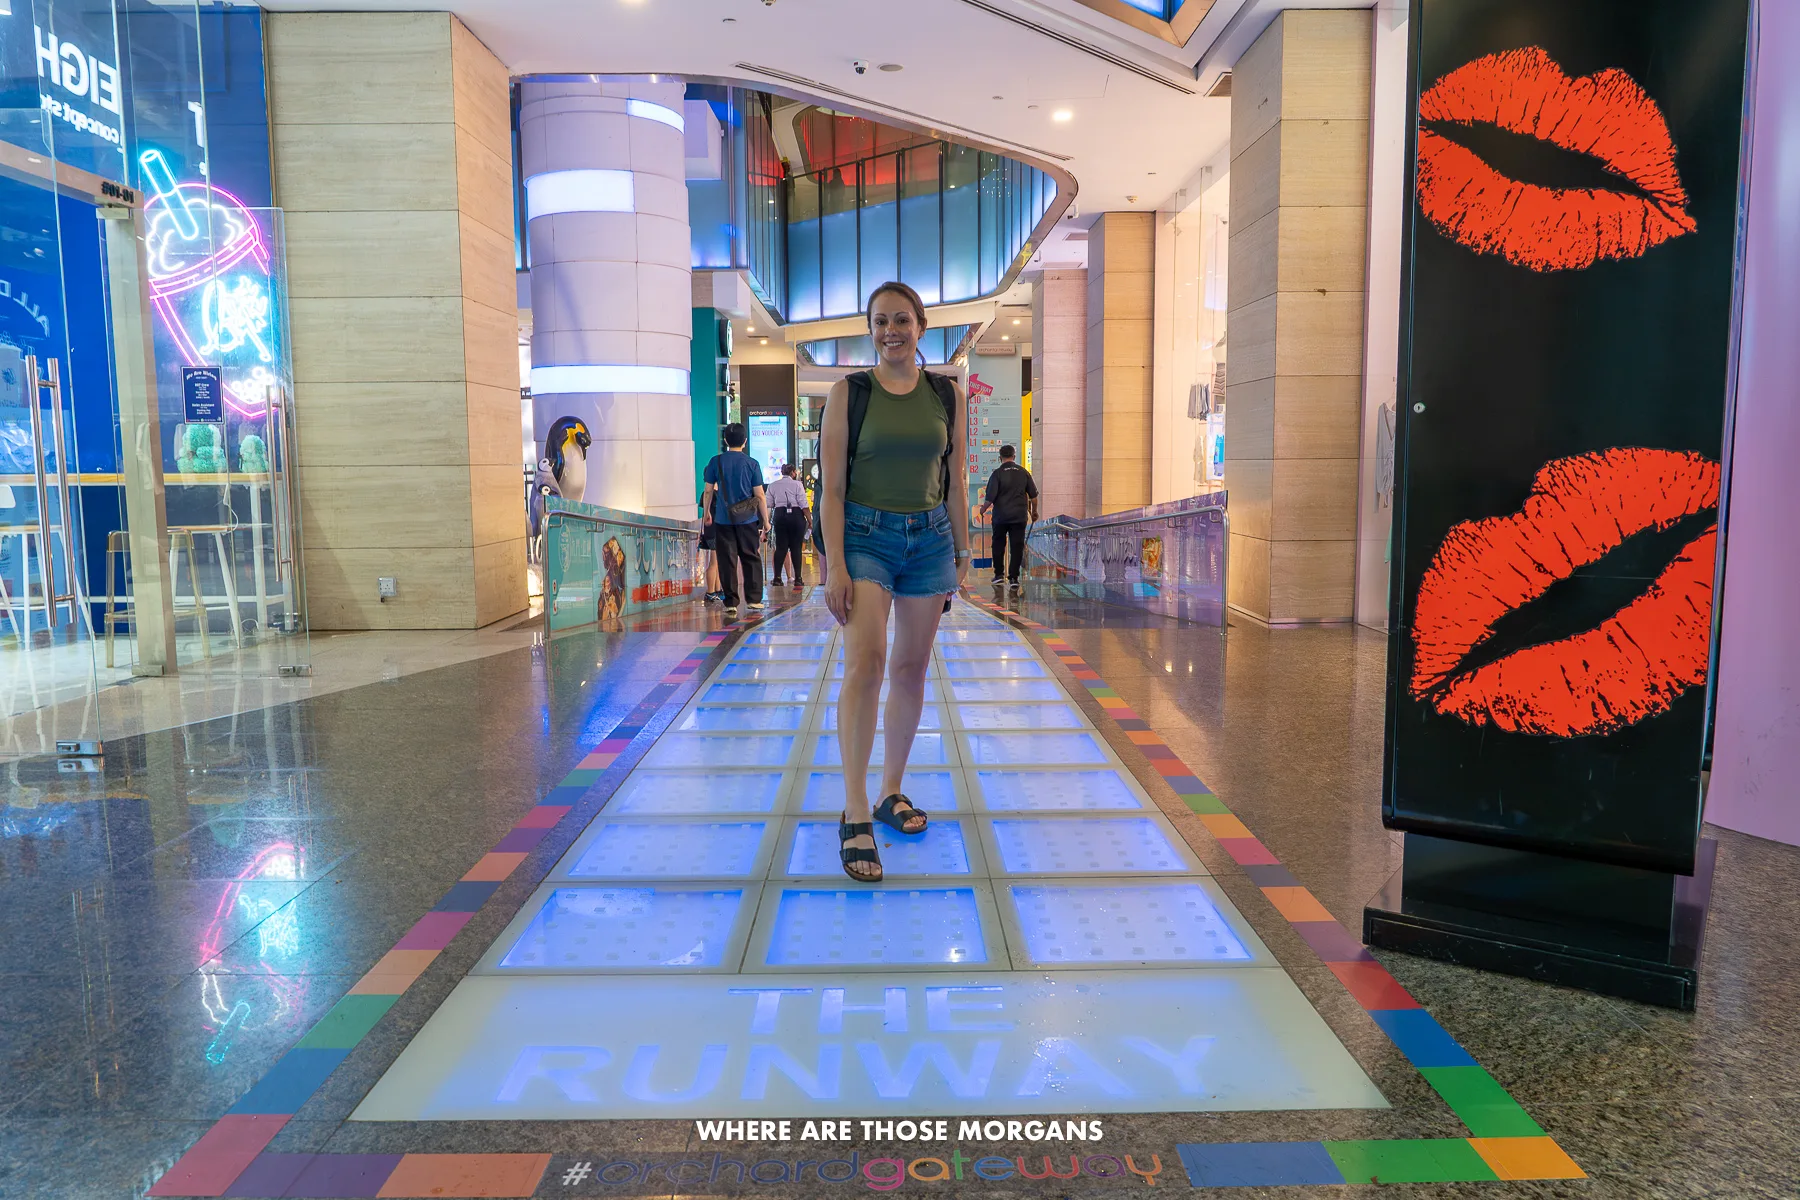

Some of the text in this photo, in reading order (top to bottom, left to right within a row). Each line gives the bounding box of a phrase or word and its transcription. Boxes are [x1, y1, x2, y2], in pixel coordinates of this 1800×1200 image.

[969, 406, 978, 415] L4
[969, 417, 979, 426] L3
[761, 429, 784, 437] VOUCHER
[969, 428, 979, 436] L2
[969, 438, 977, 447] L1
[969, 454, 978, 463] B1
[728, 986, 1014, 1034] THE
[494, 1036, 1216, 1102] RUNWAY
[562, 1149, 1163, 1191] #orchardgateway
